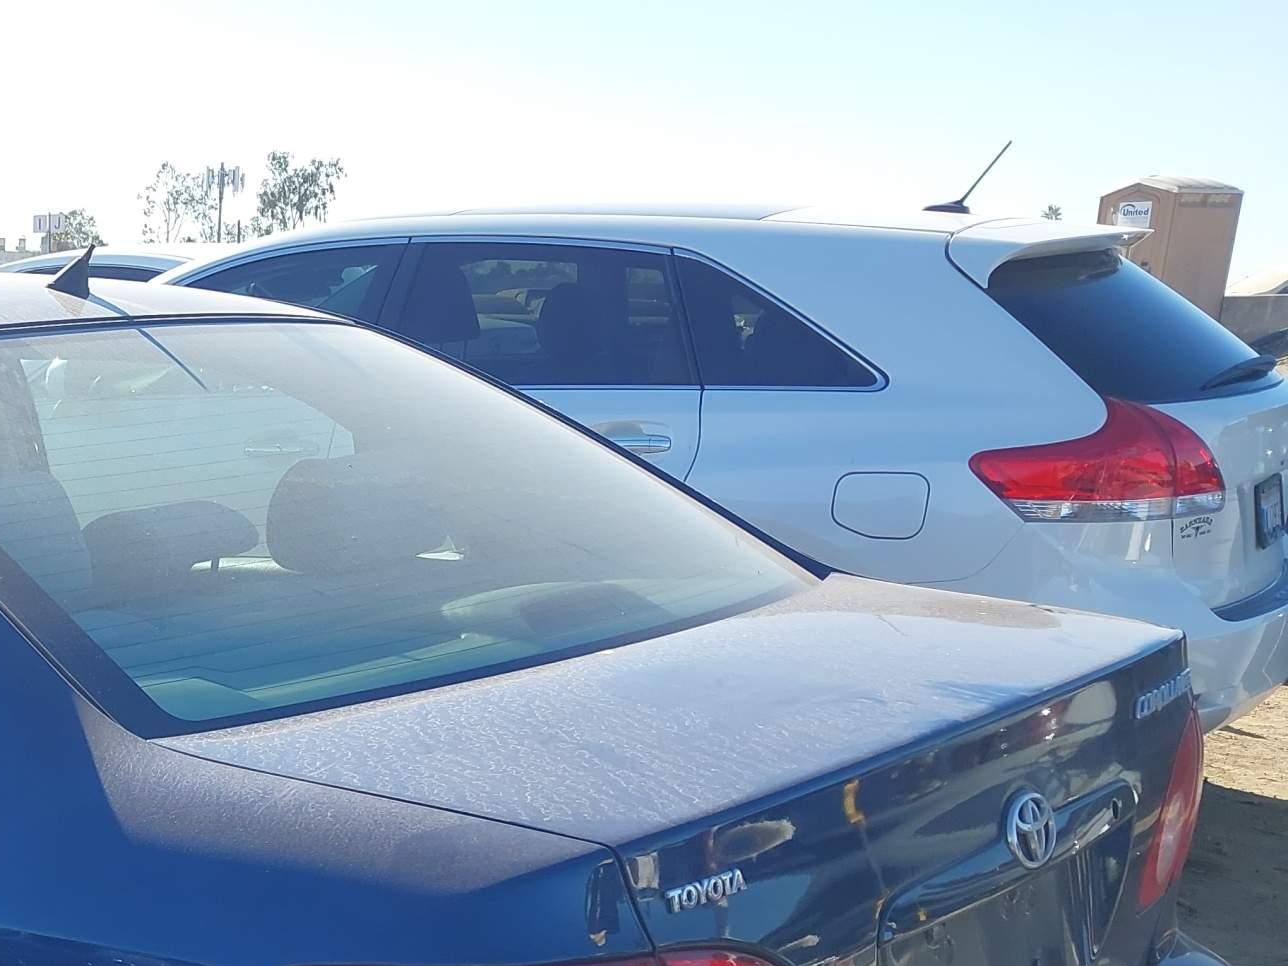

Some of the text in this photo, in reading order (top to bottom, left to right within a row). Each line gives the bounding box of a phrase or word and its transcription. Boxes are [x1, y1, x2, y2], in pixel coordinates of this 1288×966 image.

[1122, 207, 1150, 217] United
[54, 216, 61, 230] J
[665, 868, 748, 912] TOYOTA
